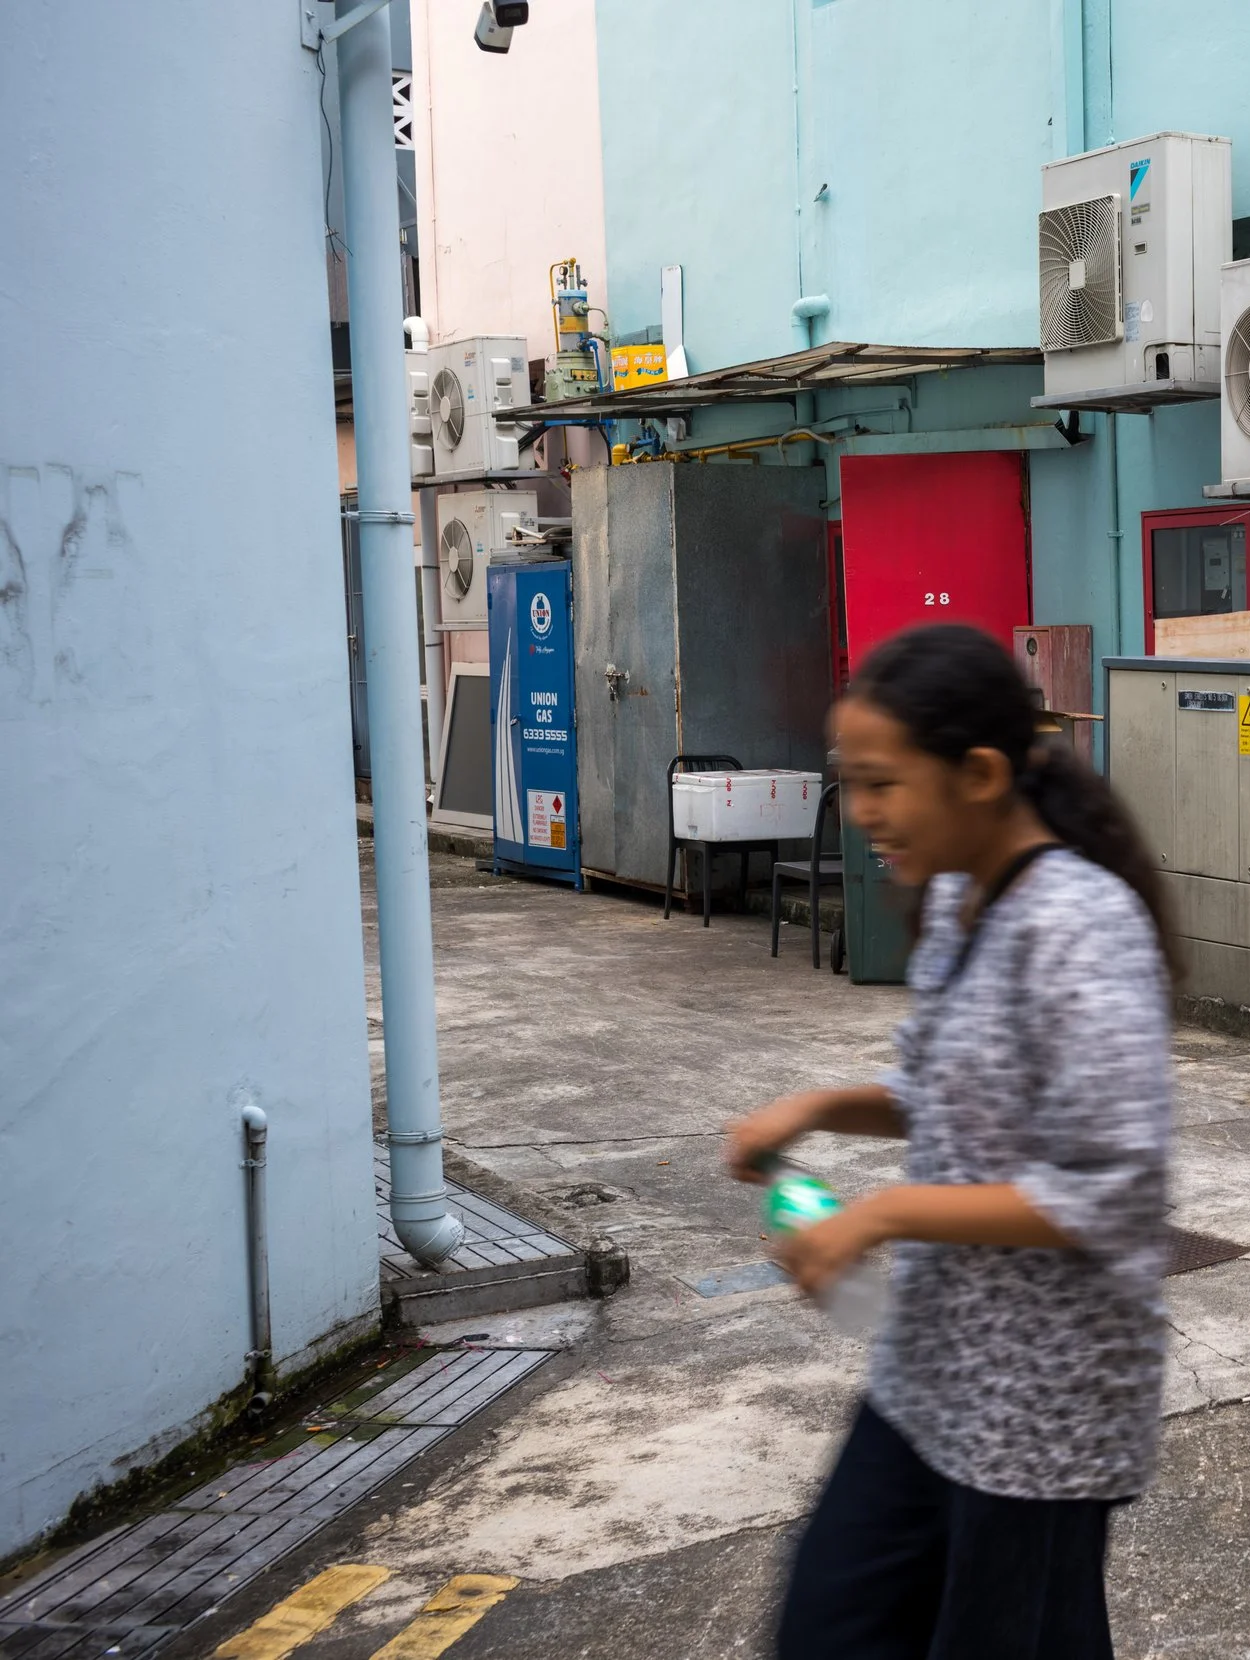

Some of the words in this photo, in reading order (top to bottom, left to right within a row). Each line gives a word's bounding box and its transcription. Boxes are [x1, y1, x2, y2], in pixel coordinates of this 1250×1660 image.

[1130, 158, 1151, 169] DAIKIN
[924, 592, 950, 605] 28
[532, 609, 550, 617] UNION
[530, 692, 558, 706] UNION
[536, 709, 552, 723] GAS
[523, 728, 545, 740] 6333
[545, 730, 568, 741] 5555
